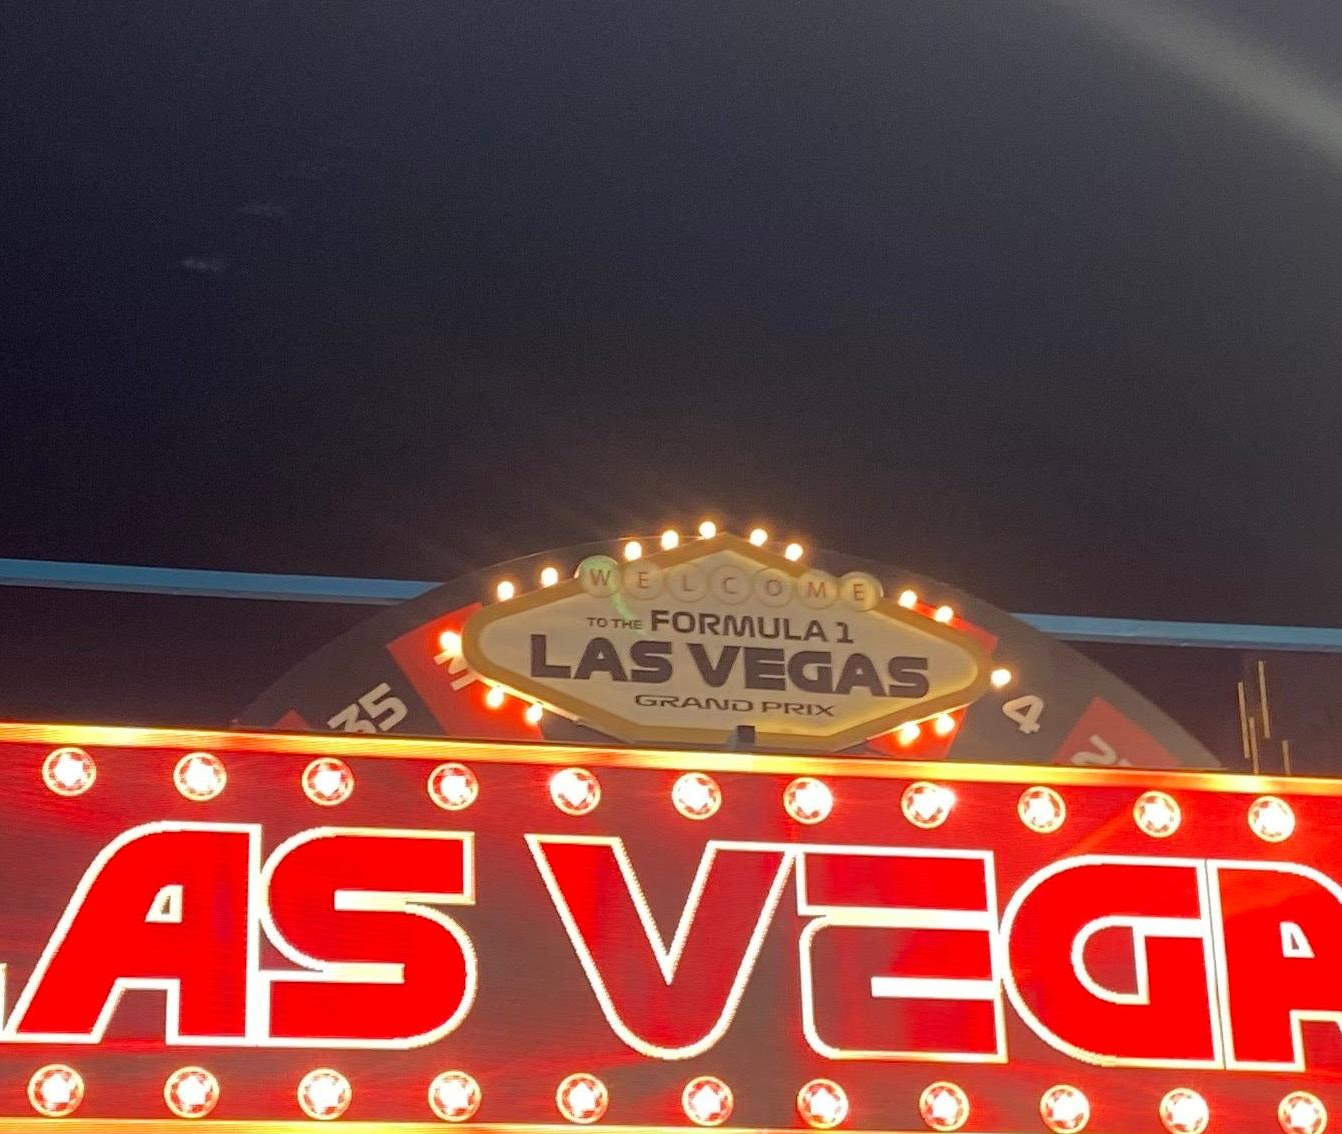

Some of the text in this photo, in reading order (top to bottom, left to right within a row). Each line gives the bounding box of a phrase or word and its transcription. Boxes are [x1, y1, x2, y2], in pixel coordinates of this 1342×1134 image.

[588, 568, 865, 601] WELCOME
[587, 609, 854, 644] TO THE FORMULA 1
[530, 633, 673, 683] LAS
[688, 643, 930, 698] VEGAS
[635, 694, 836, 717] GRAND PRIX
[1002, 695, 1045, 735] 4
